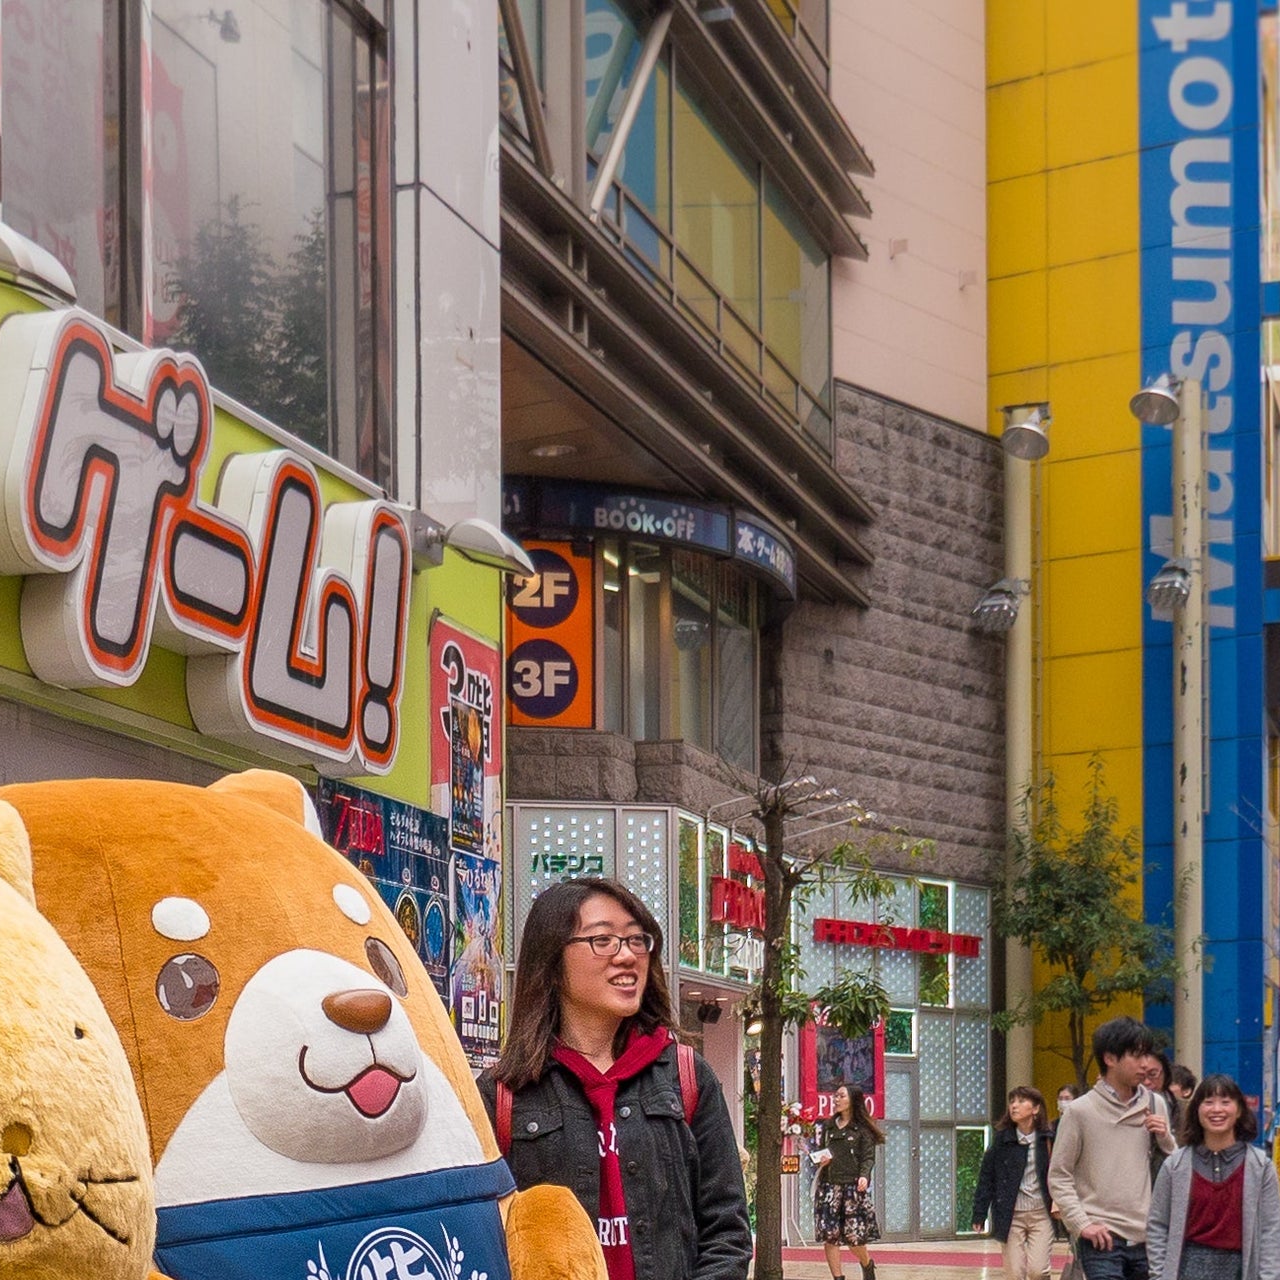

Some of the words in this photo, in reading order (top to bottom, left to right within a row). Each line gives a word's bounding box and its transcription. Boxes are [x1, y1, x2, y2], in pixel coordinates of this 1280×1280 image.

[512, 571, 570, 608] 2F
[512, 660, 570, 697] 3F
[531, 854, 604, 873] パチンコ
